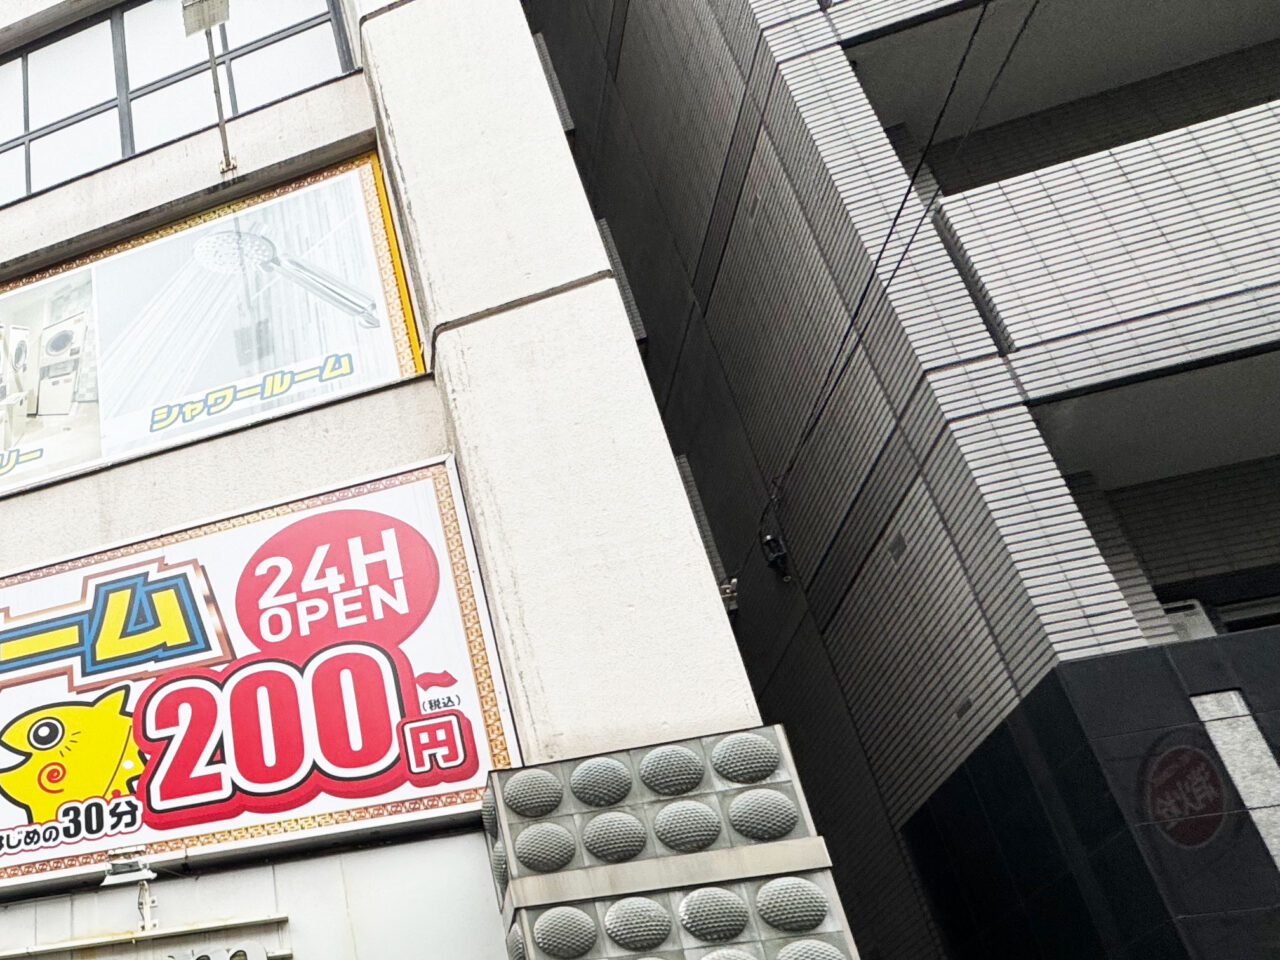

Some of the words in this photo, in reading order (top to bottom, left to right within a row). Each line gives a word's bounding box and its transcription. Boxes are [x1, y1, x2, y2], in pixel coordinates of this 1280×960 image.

[150, 353, 353, 434] シャワールーム
[256, 527, 398, 610] 24H
[257, 580, 412, 644] OPEN
[147, 644, 402, 810] 200
